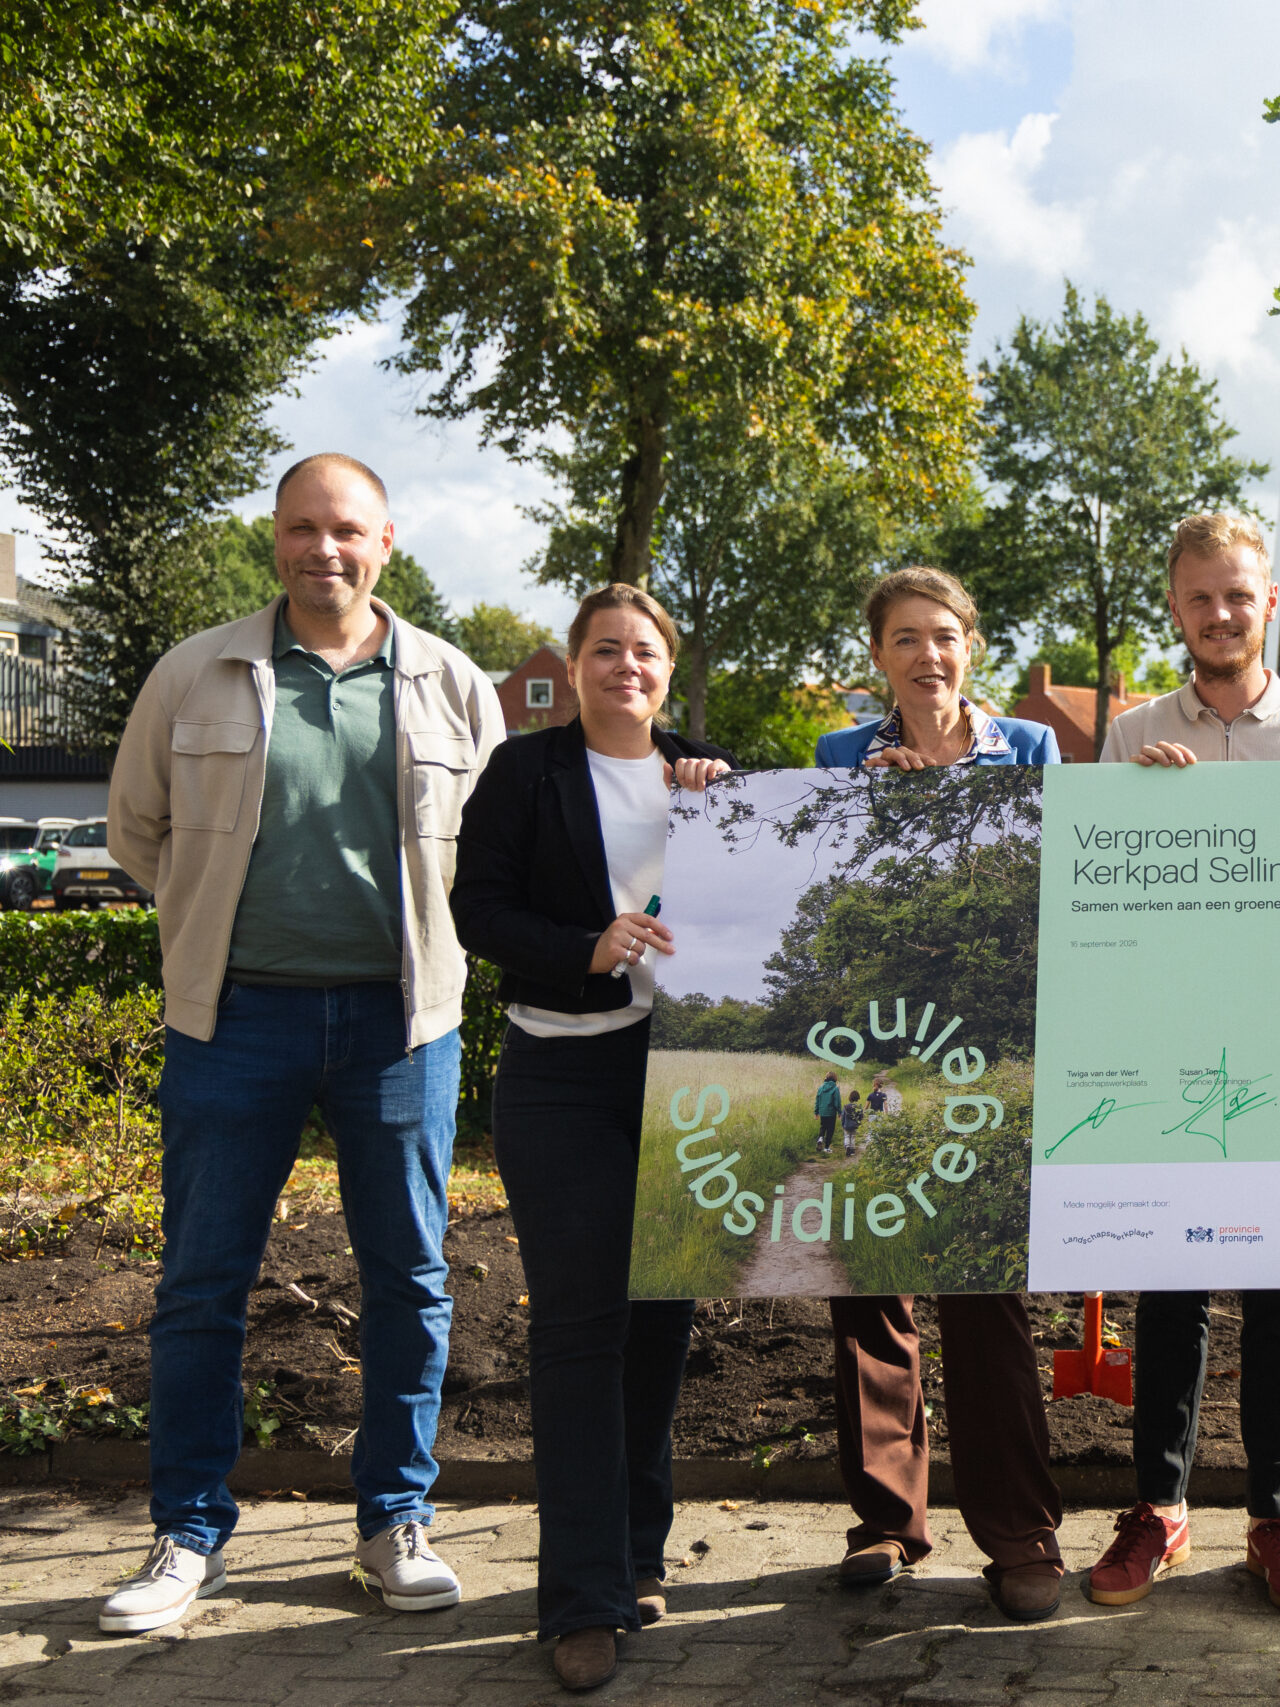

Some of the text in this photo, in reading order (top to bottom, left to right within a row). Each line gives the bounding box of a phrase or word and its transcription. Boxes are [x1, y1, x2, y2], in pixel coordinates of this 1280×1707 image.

[1073, 823, 1257, 856] Vergroening
[1073, 858, 1198, 890] Kerkpad
[1071, 899, 1119, 912] Samen
[1122, 899, 1174, 912] werken
[1176, 901, 1202, 911] aan
[1205, 900, 1231, 911] een
[1079, 940, 1117, 949] september
[1066, 1069, 1089, 1079] Twiga
[1105, 1069, 1119, 1077] der
[1120, 1069, 1139, 1077] Werf
[1179, 1068, 1203, 1076] Susan
[1066, 1079, 1148, 1089] Landschapswerkplaats
[1179, 1078, 1213, 1086] Provincie
[669, 997, 1005, 1244] Subsidieregeling
[1063, 1199, 1171, 1210] Mede mogelijk gemaakt door:
[1219, 1225, 1261, 1235] provincie
[1219, 1235, 1264, 1245] groningen
